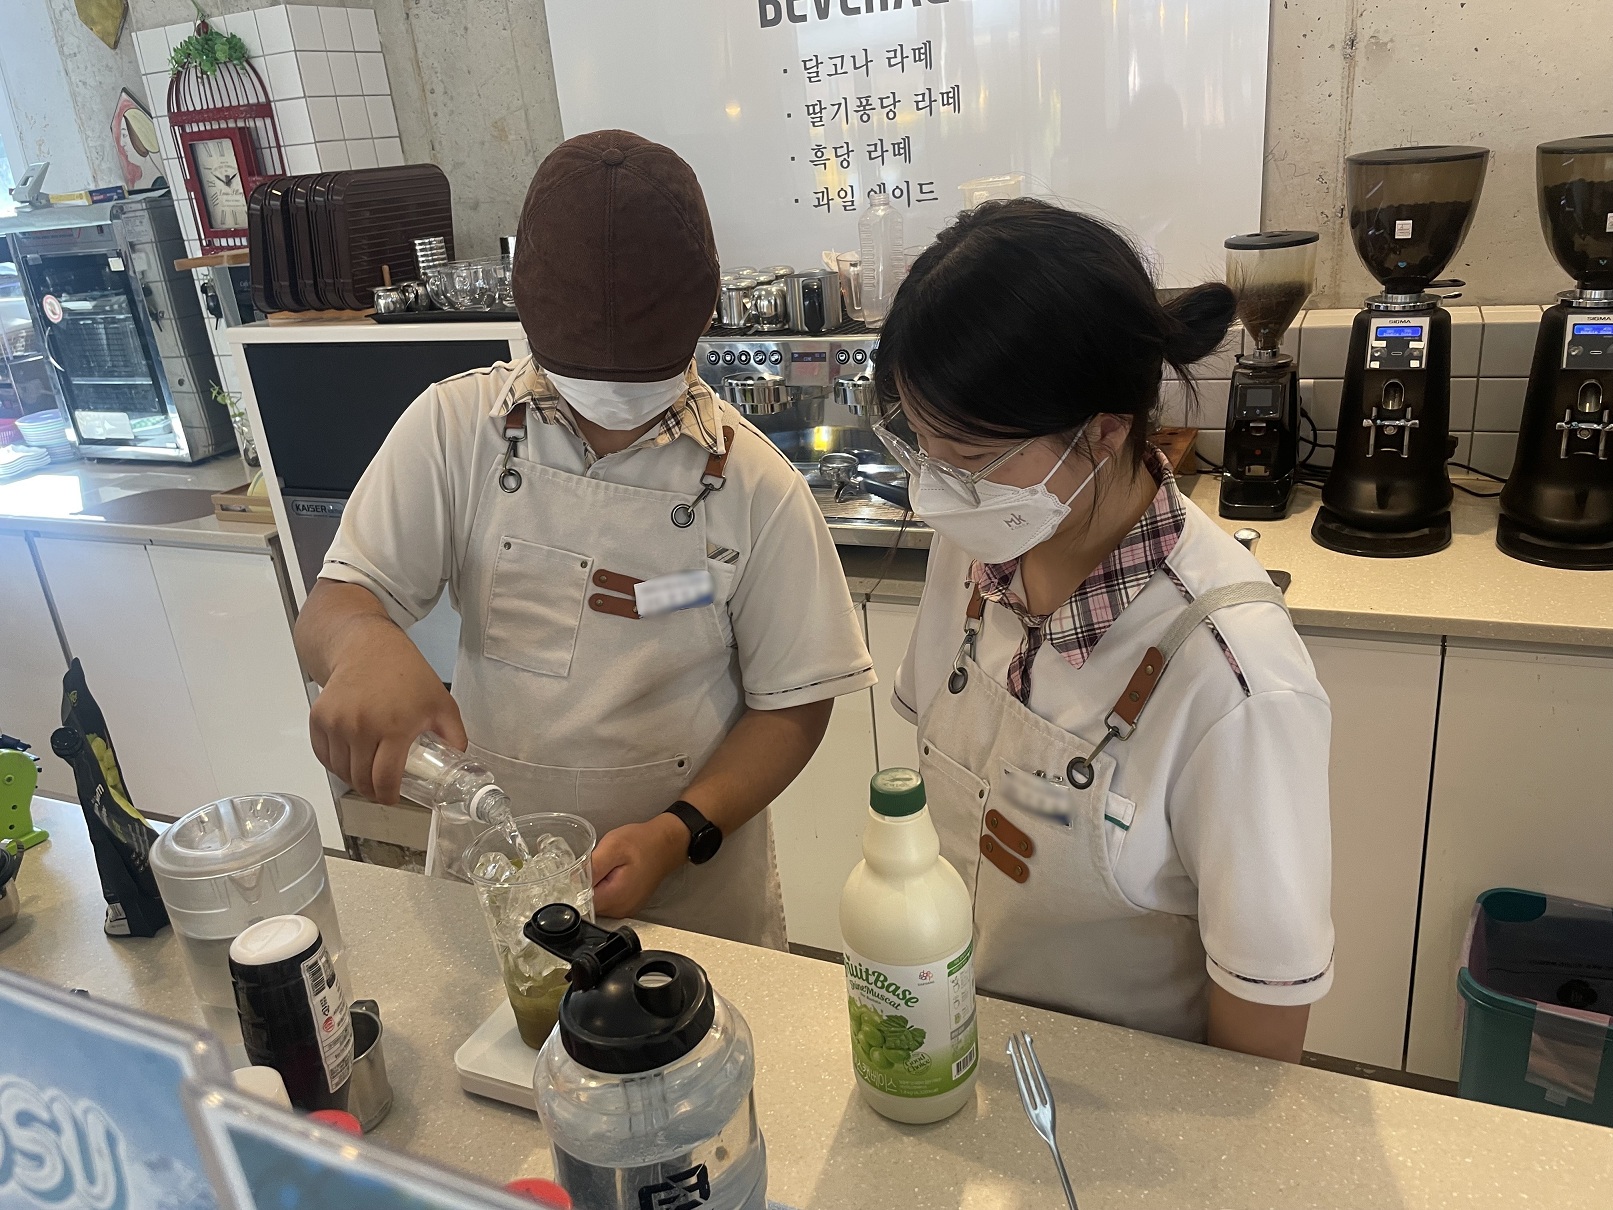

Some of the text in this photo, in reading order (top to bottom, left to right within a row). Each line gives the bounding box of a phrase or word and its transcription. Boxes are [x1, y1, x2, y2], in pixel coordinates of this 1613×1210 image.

[801, 40, 933, 83] 달고나 라떼
[805, 85, 961, 127] 딸기퐁당 라떼
[809, 136, 912, 170] 흑당 라떼
[813, 185, 856, 213] 과일
[295, 503, 327, 513] KAISER
